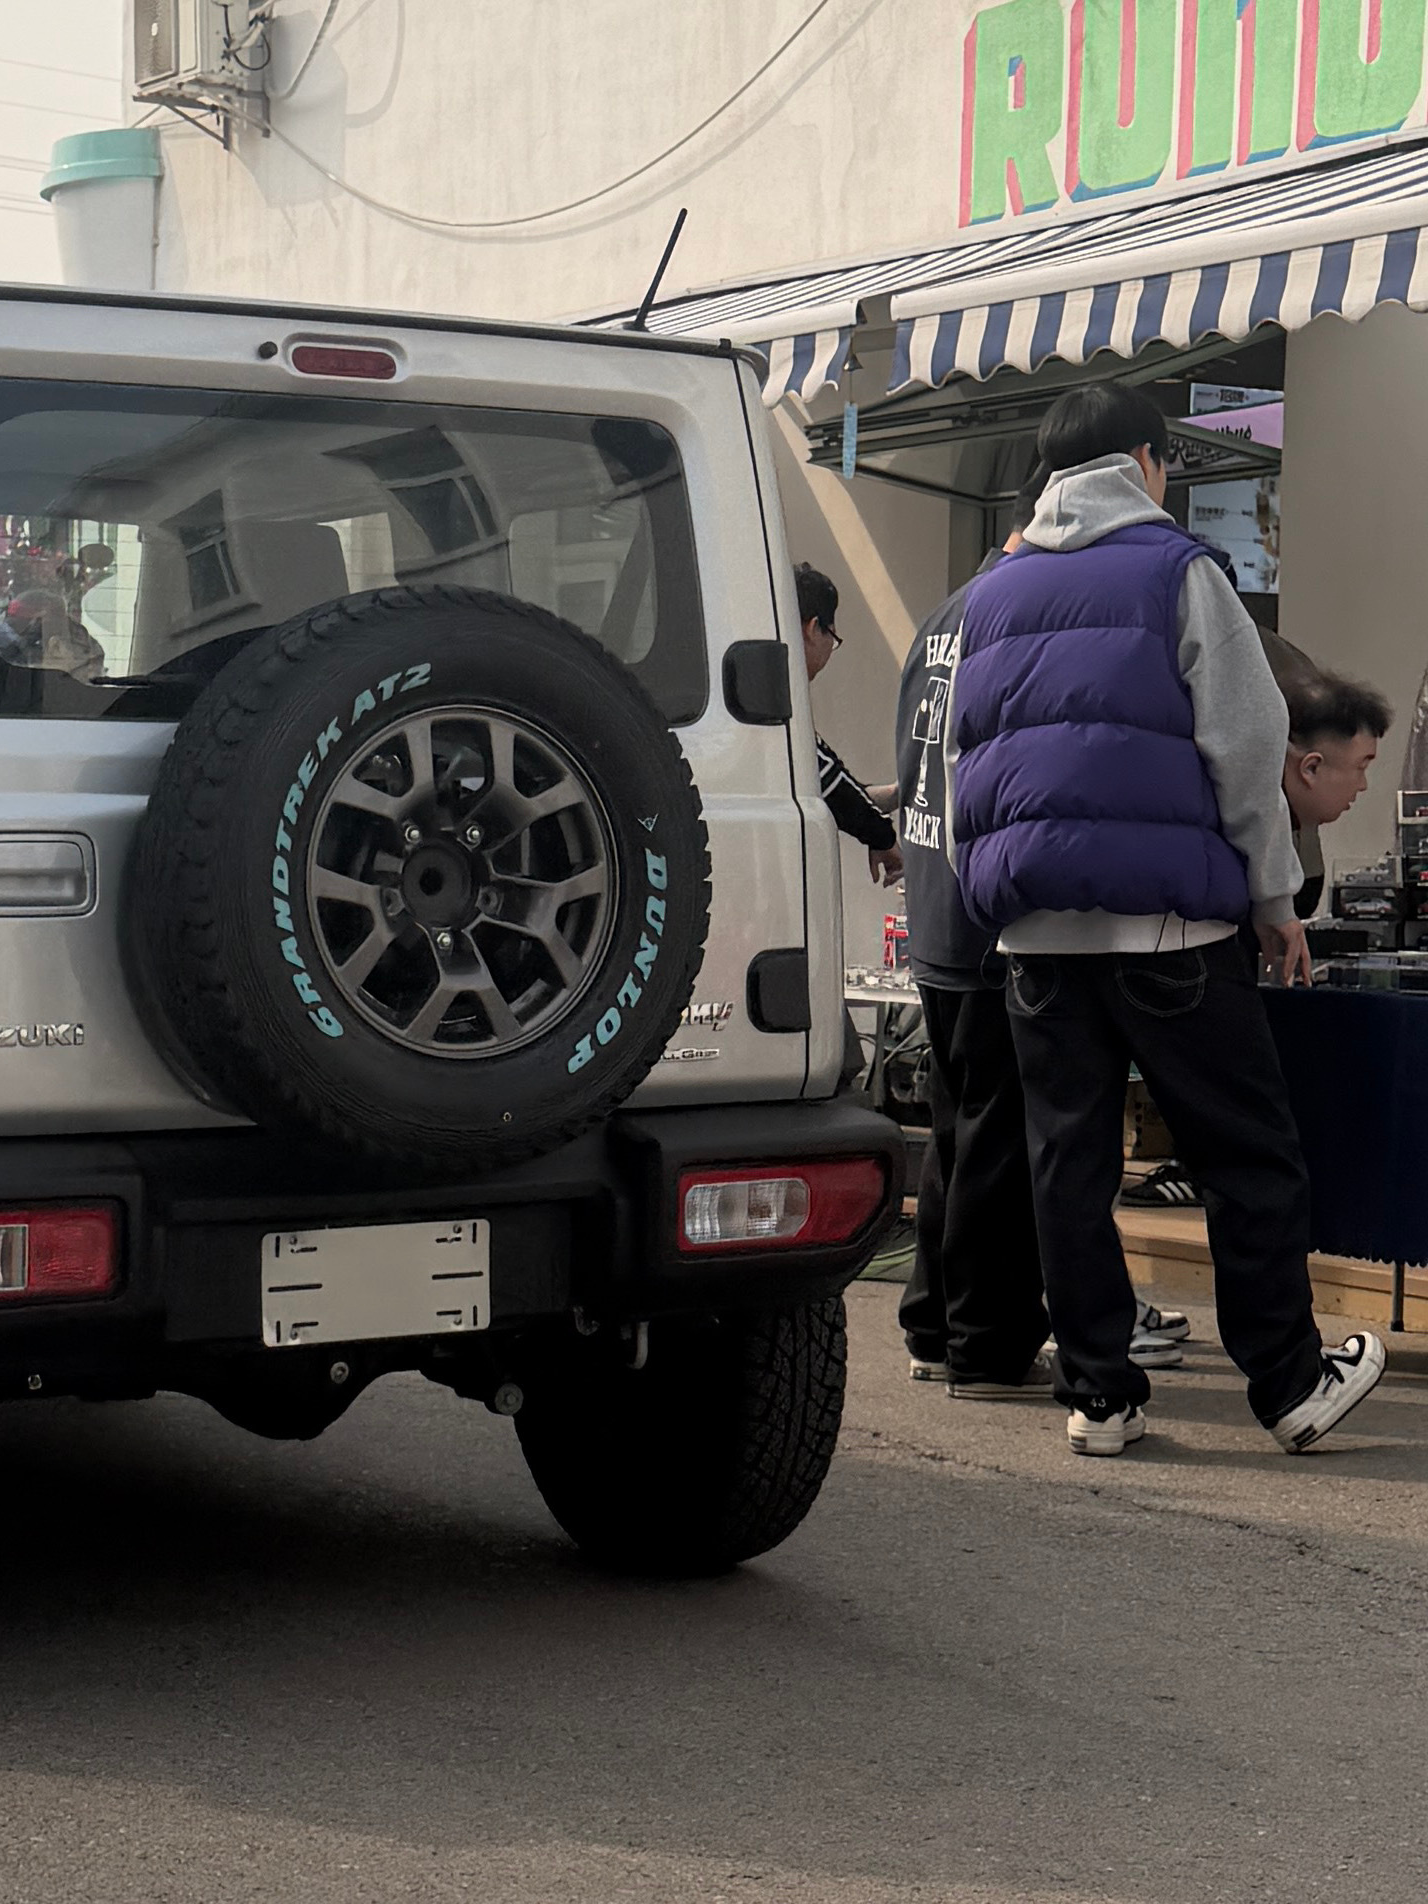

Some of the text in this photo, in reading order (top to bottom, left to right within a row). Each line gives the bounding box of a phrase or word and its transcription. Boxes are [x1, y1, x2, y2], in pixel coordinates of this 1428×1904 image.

[271, 662, 432, 1039] GRANDTREK AT2
[567, 847, 668, 1075] DUNLOP
